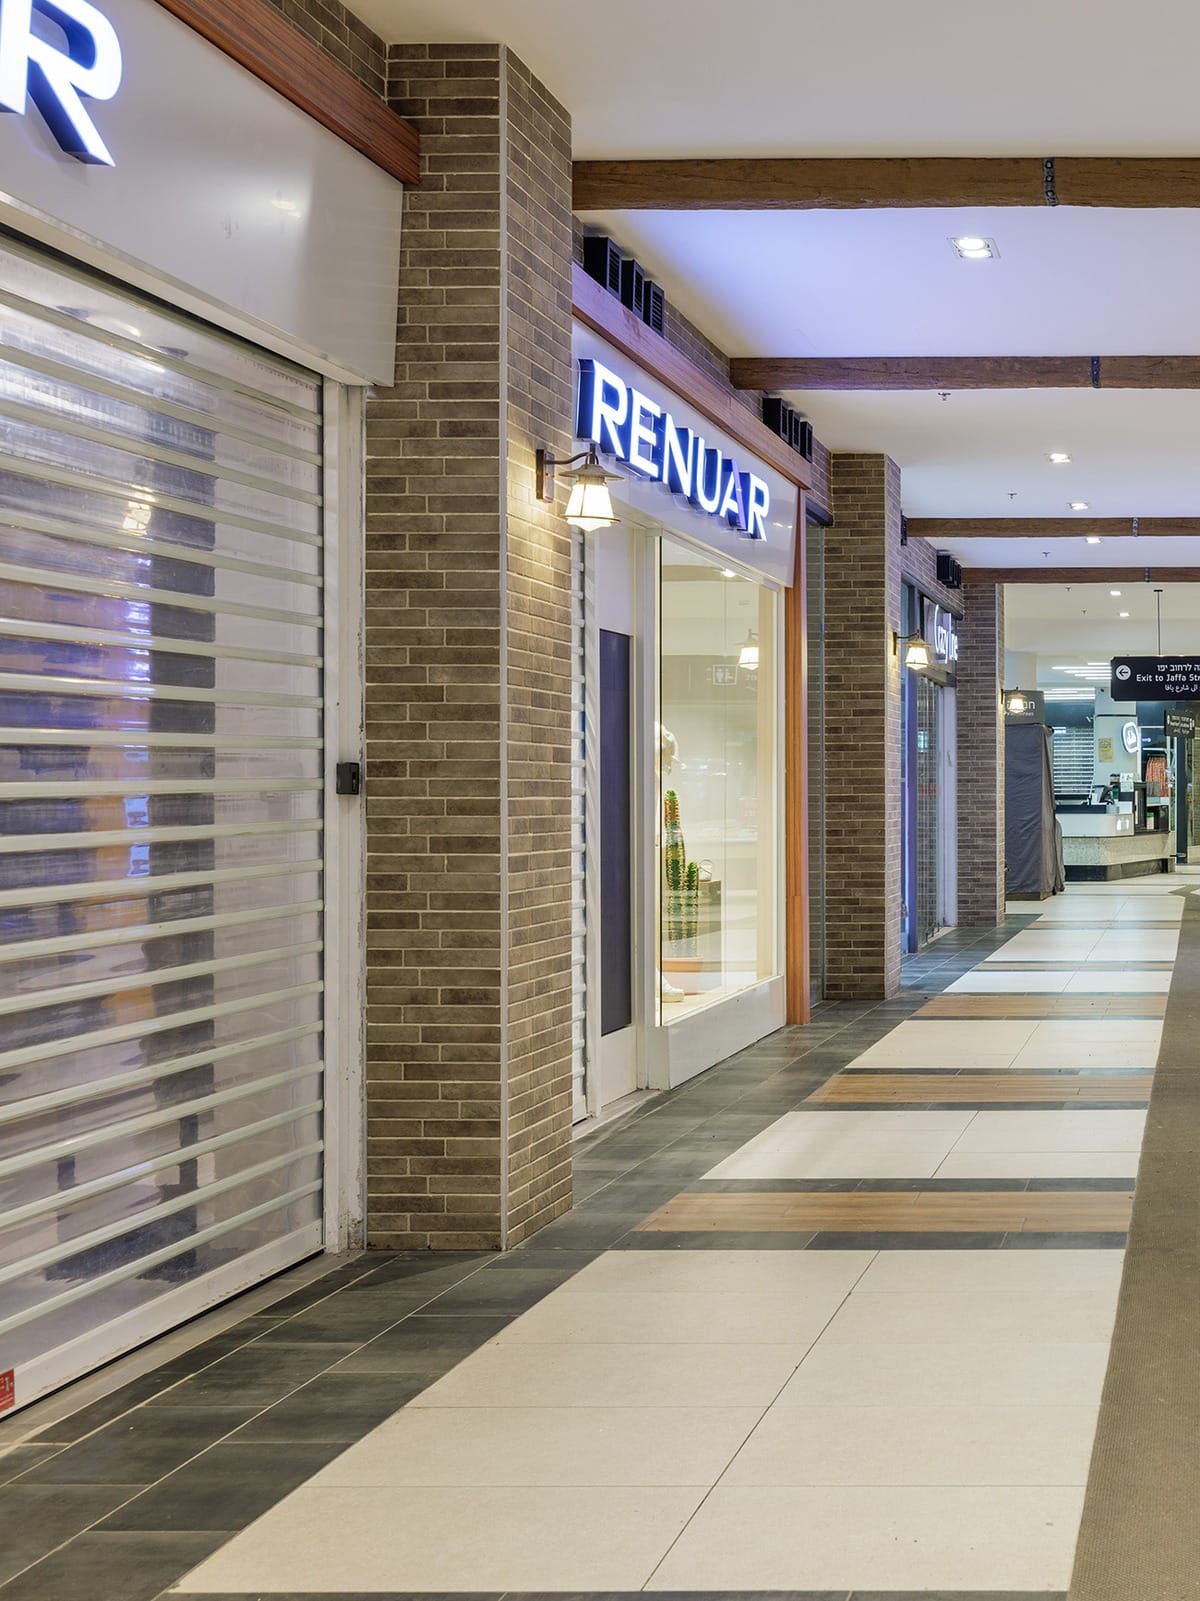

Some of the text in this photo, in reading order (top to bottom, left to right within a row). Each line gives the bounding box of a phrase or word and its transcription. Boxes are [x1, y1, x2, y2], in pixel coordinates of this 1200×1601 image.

[584, 358, 769, 542] RENUAR
[1157, 664, 1168, 672] יפו
[1169, 663, 1192, 672] לרחוב
[1136, 674, 1152, 682] Exit
[1155, 674, 1164, 682] to
[1166, 673, 1187, 682] Jaffa
